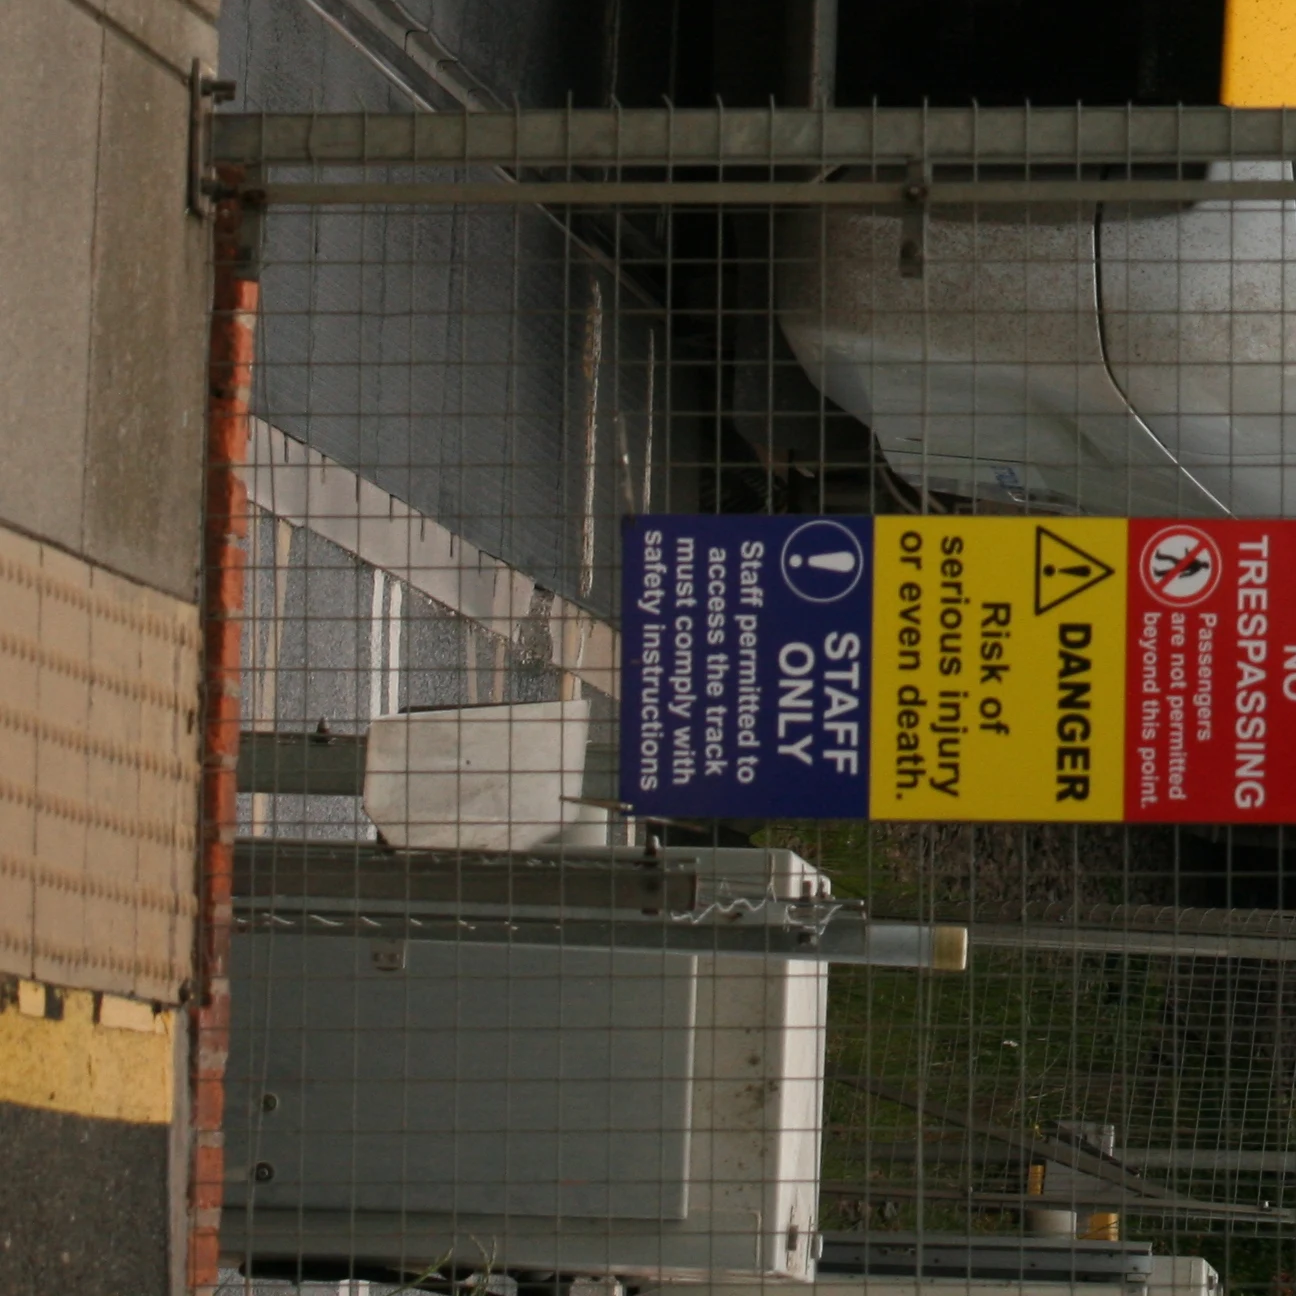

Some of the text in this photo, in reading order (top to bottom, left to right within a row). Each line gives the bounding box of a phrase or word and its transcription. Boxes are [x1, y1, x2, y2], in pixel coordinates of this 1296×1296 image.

[638, 530, 668, 791] safety instructions
[668, 537, 698, 784] must comply with
[704, 547, 730, 776] access the track
[734, 540, 764, 784] Staff permitted to
[777, 642, 815, 765] ONLY
[822, 631, 860, 775] STAFF
[896, 530, 928, 800] or even death.
[928, 536, 970, 798] serious injury
[978, 602, 1012, 736] Risk of
[1056, 623, 1092, 802] DANGER
[1137, 612, 1162, 808] beyond this point.
[1165, 612, 1188, 800] are not permitted
[1193, 612, 1218, 742] Passengers
[1234, 534, 1269, 808] TRESPASSING
